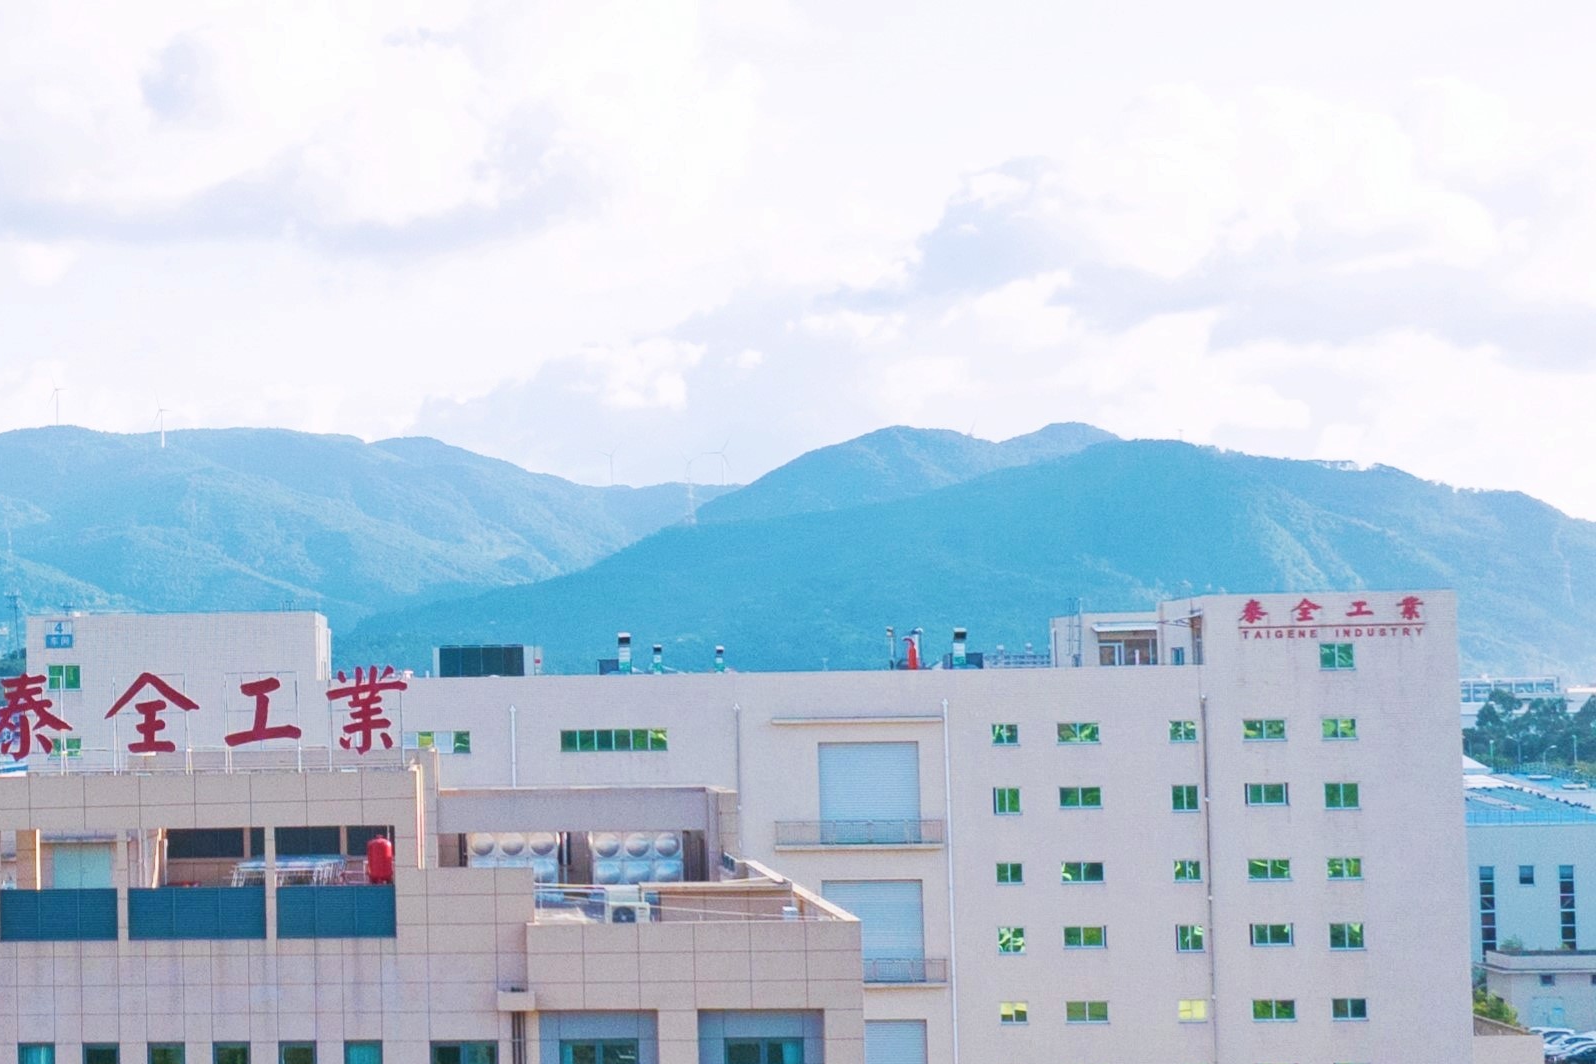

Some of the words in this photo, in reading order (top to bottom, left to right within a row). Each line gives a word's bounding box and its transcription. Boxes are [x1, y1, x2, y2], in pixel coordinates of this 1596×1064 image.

[1238, 596, 1424, 624] 泰全工業
[54, 622, 64, 634] 4
[1242, 629, 1318, 640] TAIGENE
[1335, 627, 1425, 638] INDUSTRY
